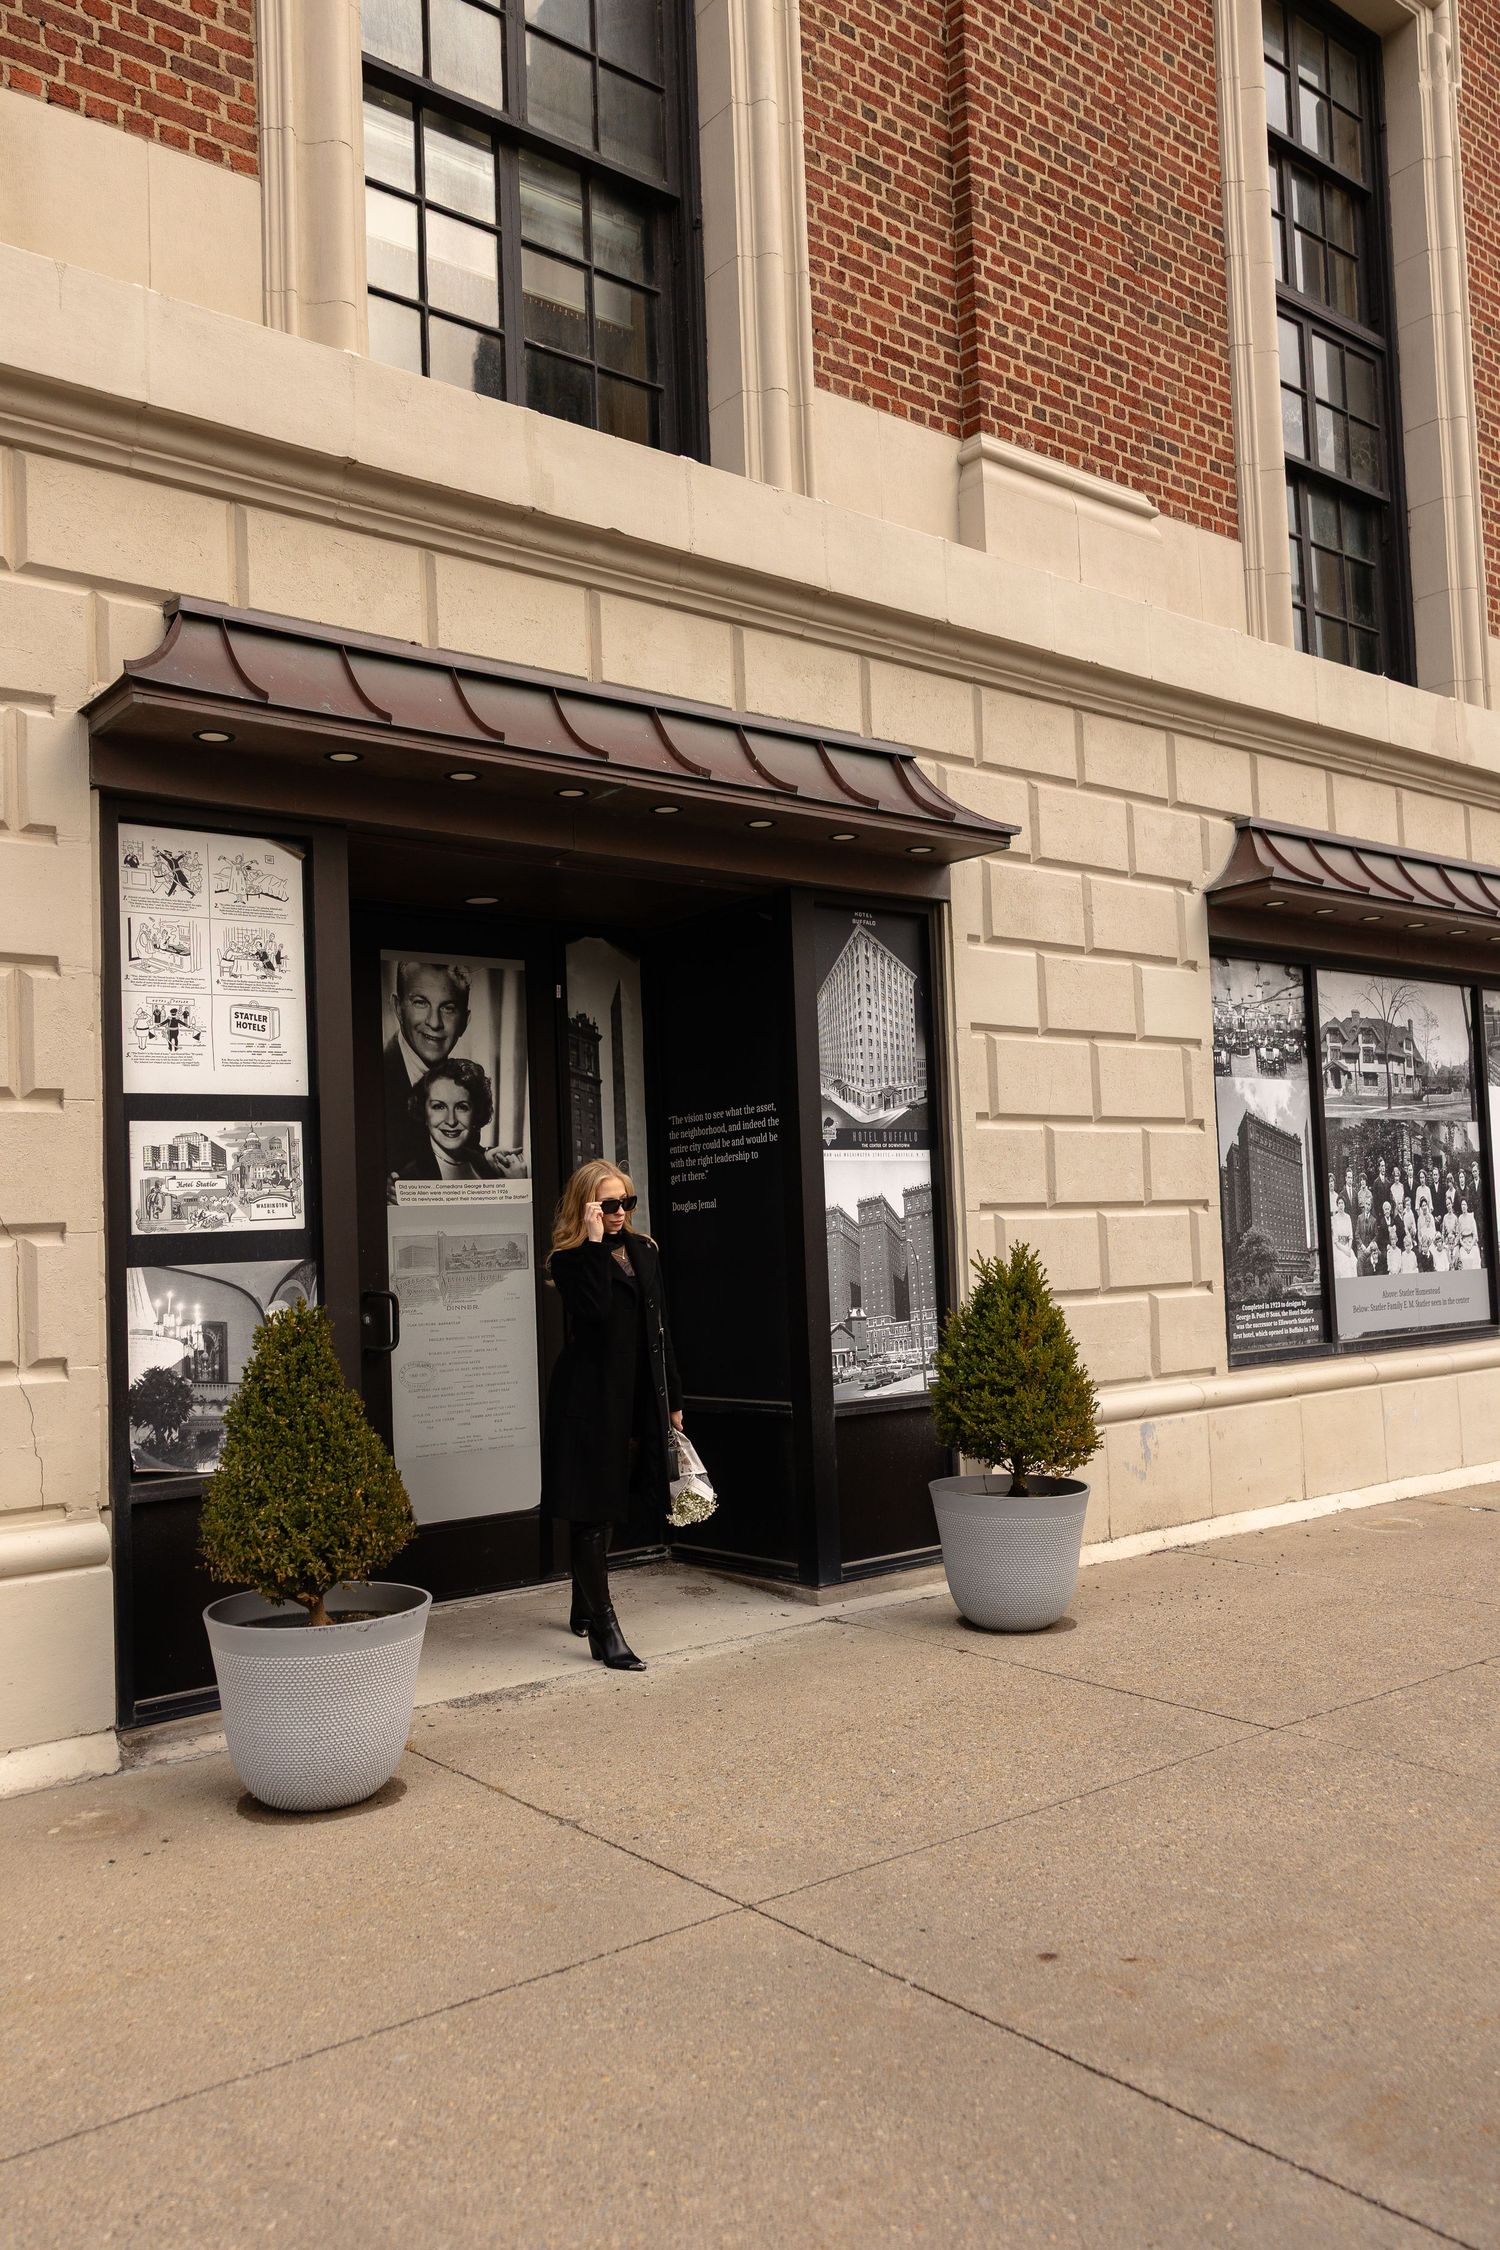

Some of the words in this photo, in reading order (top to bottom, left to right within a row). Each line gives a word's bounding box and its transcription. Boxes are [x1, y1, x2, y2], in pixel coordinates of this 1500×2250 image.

[234, 1011, 268, 1023] STATLER
[236, 1021, 266, 1032] HOTELS
[684, 1113, 704, 1123] vision
[705, 1112, 711, 1120] to
[713, 1110, 724, 1119] see
[725, 1106, 742, 1117] what
[744, 1105, 755, 1114] the
[756, 1102, 776, 1112] asset,
[669, 1130, 679, 1140] the
[680, 1123, 727, 1139] neighborhood,
[728, 1121, 741, 1132] and
[742, 1118, 766, 1130] indeed
[768, 1116, 780, 1126] the
[853, 1131, 877, 1142] HOTEL
[883, 1131, 918, 1142] BUFFALO
[670, 1144, 688, 1154] entire
[689, 1142, 702, 1153] city
[702, 1139, 721, 1150] could
[722, 1138, 730, 1148] be
[731, 1136, 744, 1146] and
[746, 1132, 767, 1144] would
[768, 1132, 778, 1142] be
[670, 1158, 684, 1168] with
[686, 1157, 696, 1166] the
[697, 1154, 714, 1167] right
[714, 1151, 750, 1163] leadership
[751, 1151, 758, 1159] to
[176, 1180, 193, 1189] Hotel
[671, 1174, 680, 1185] get
[681, 1173, 686, 1182] it
[672, 1200, 697, 1213] Douglas
[698, 1198, 716, 1211] Jemal
[1382, 1290, 1398, 1298] Above:
[1399, 1289, 1414, 1297] Statler
[1415, 1287, 1440, 1296] Homestead
[1242, 1302, 1264, 1311] Completed
[1352, 1304, 1370, 1313] Below:
[1370, 1303, 1386, 1312] Statler
[1387, 1301, 1403, 1311] Family
[1415, 1299, 1430, 1307] Statler
[1236, 1313, 1251, 1321] George
[1268, 1328, 1284, 1337] opened
